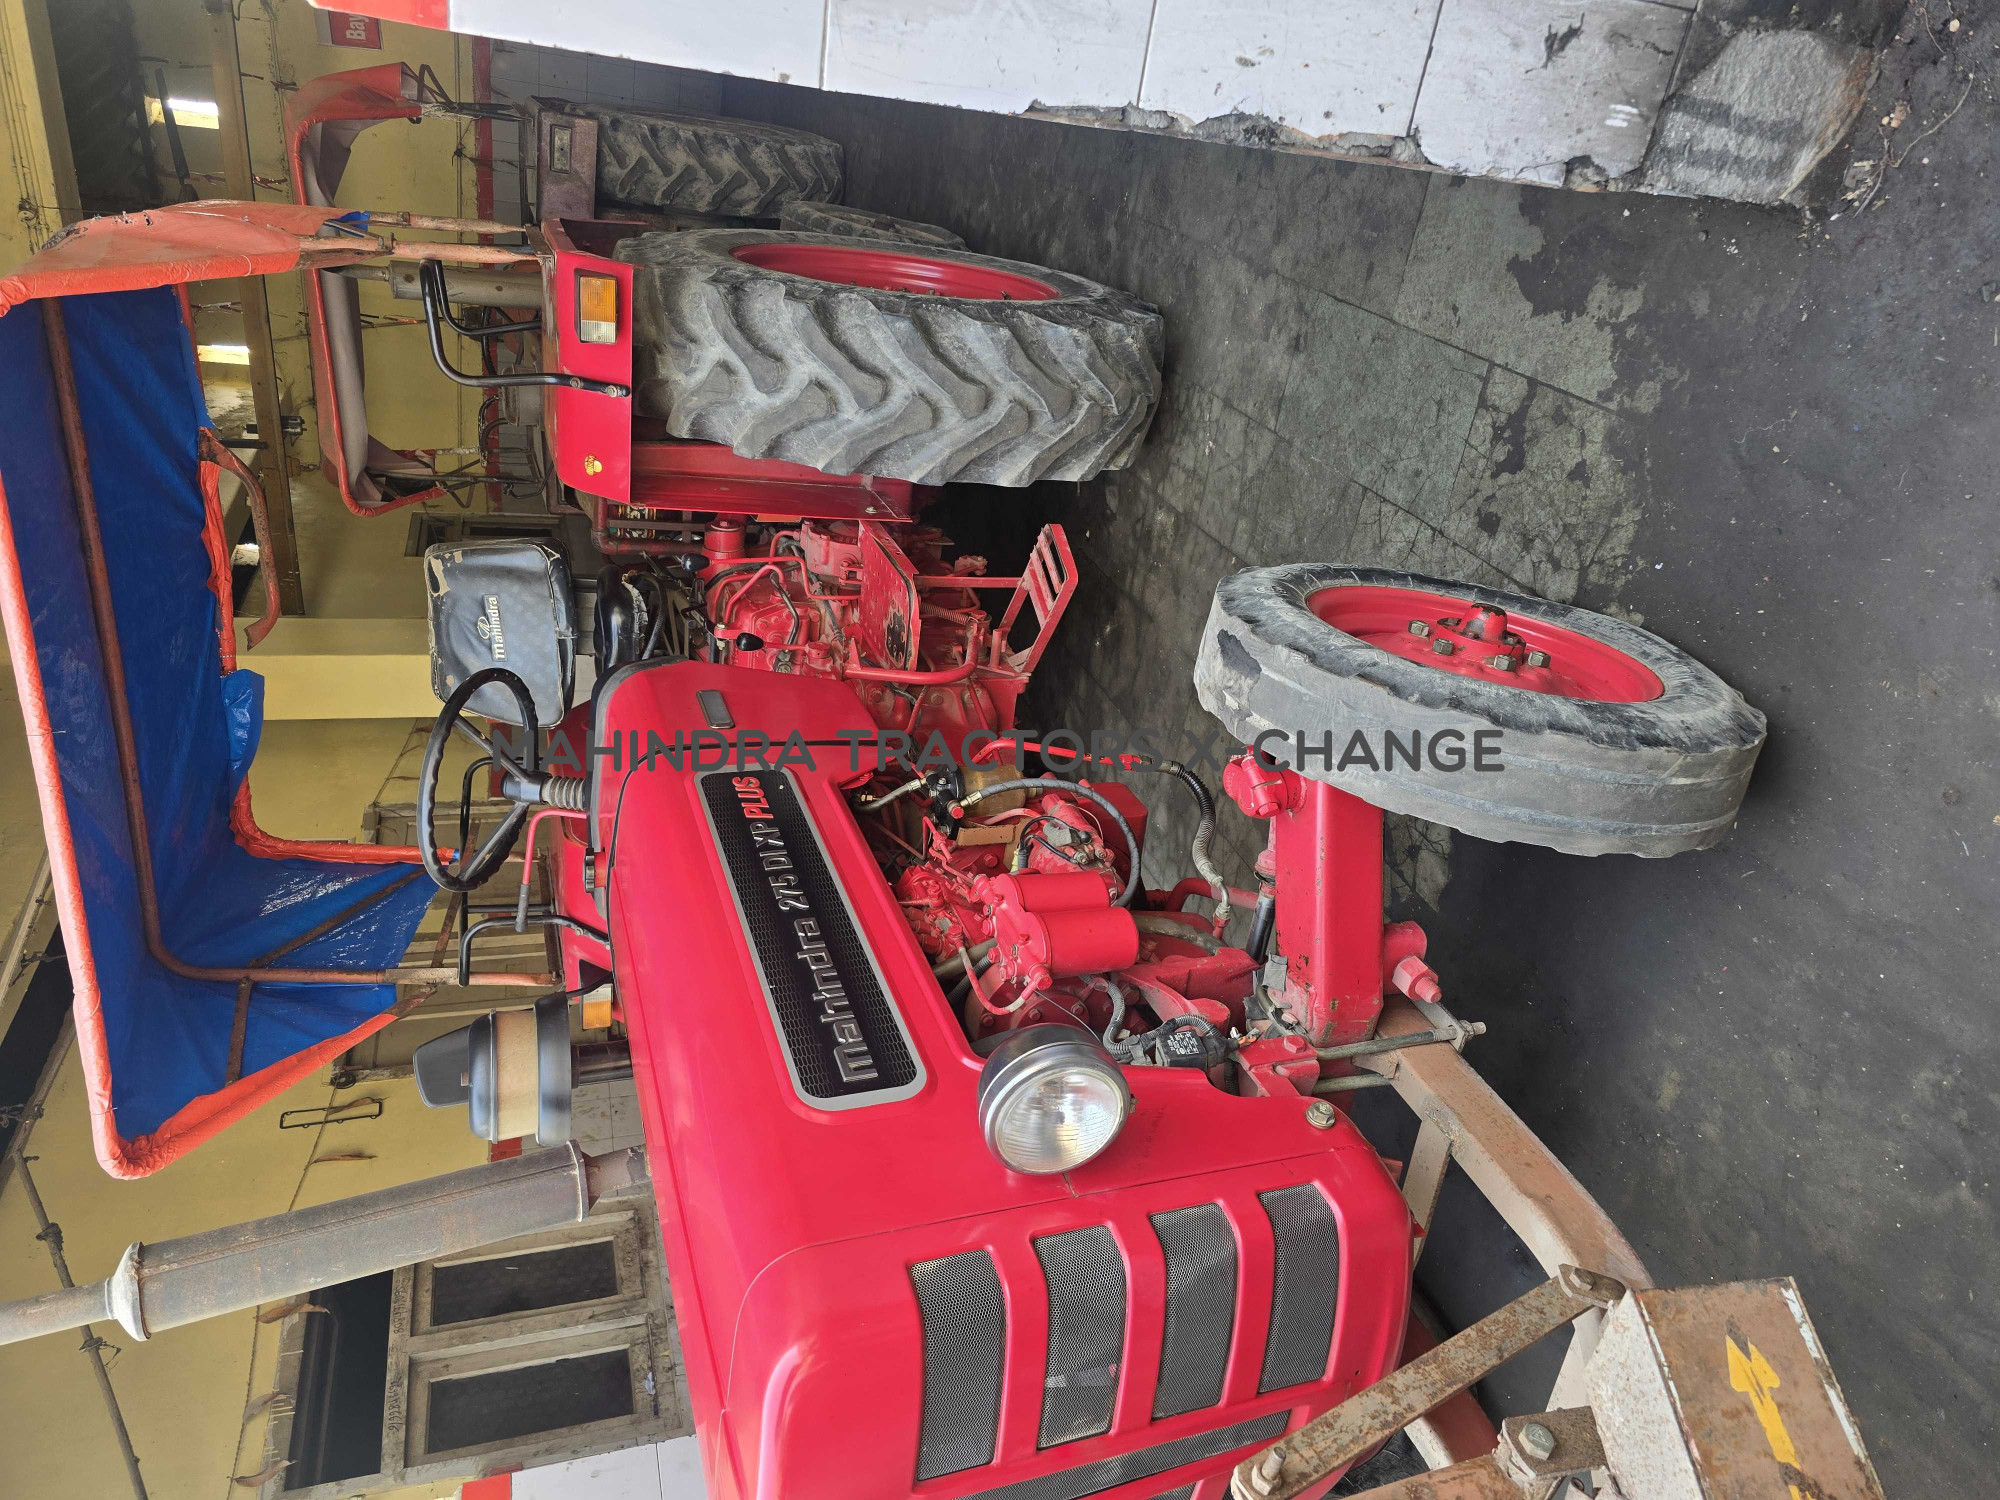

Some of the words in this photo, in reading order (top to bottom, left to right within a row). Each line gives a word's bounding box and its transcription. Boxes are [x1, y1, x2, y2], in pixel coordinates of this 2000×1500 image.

[487, 597, 506, 660] mahindra
[732, 776, 774, 819] PLUS
[768, 873, 810, 911] 275
[794, 916, 879, 1083] mahindra
